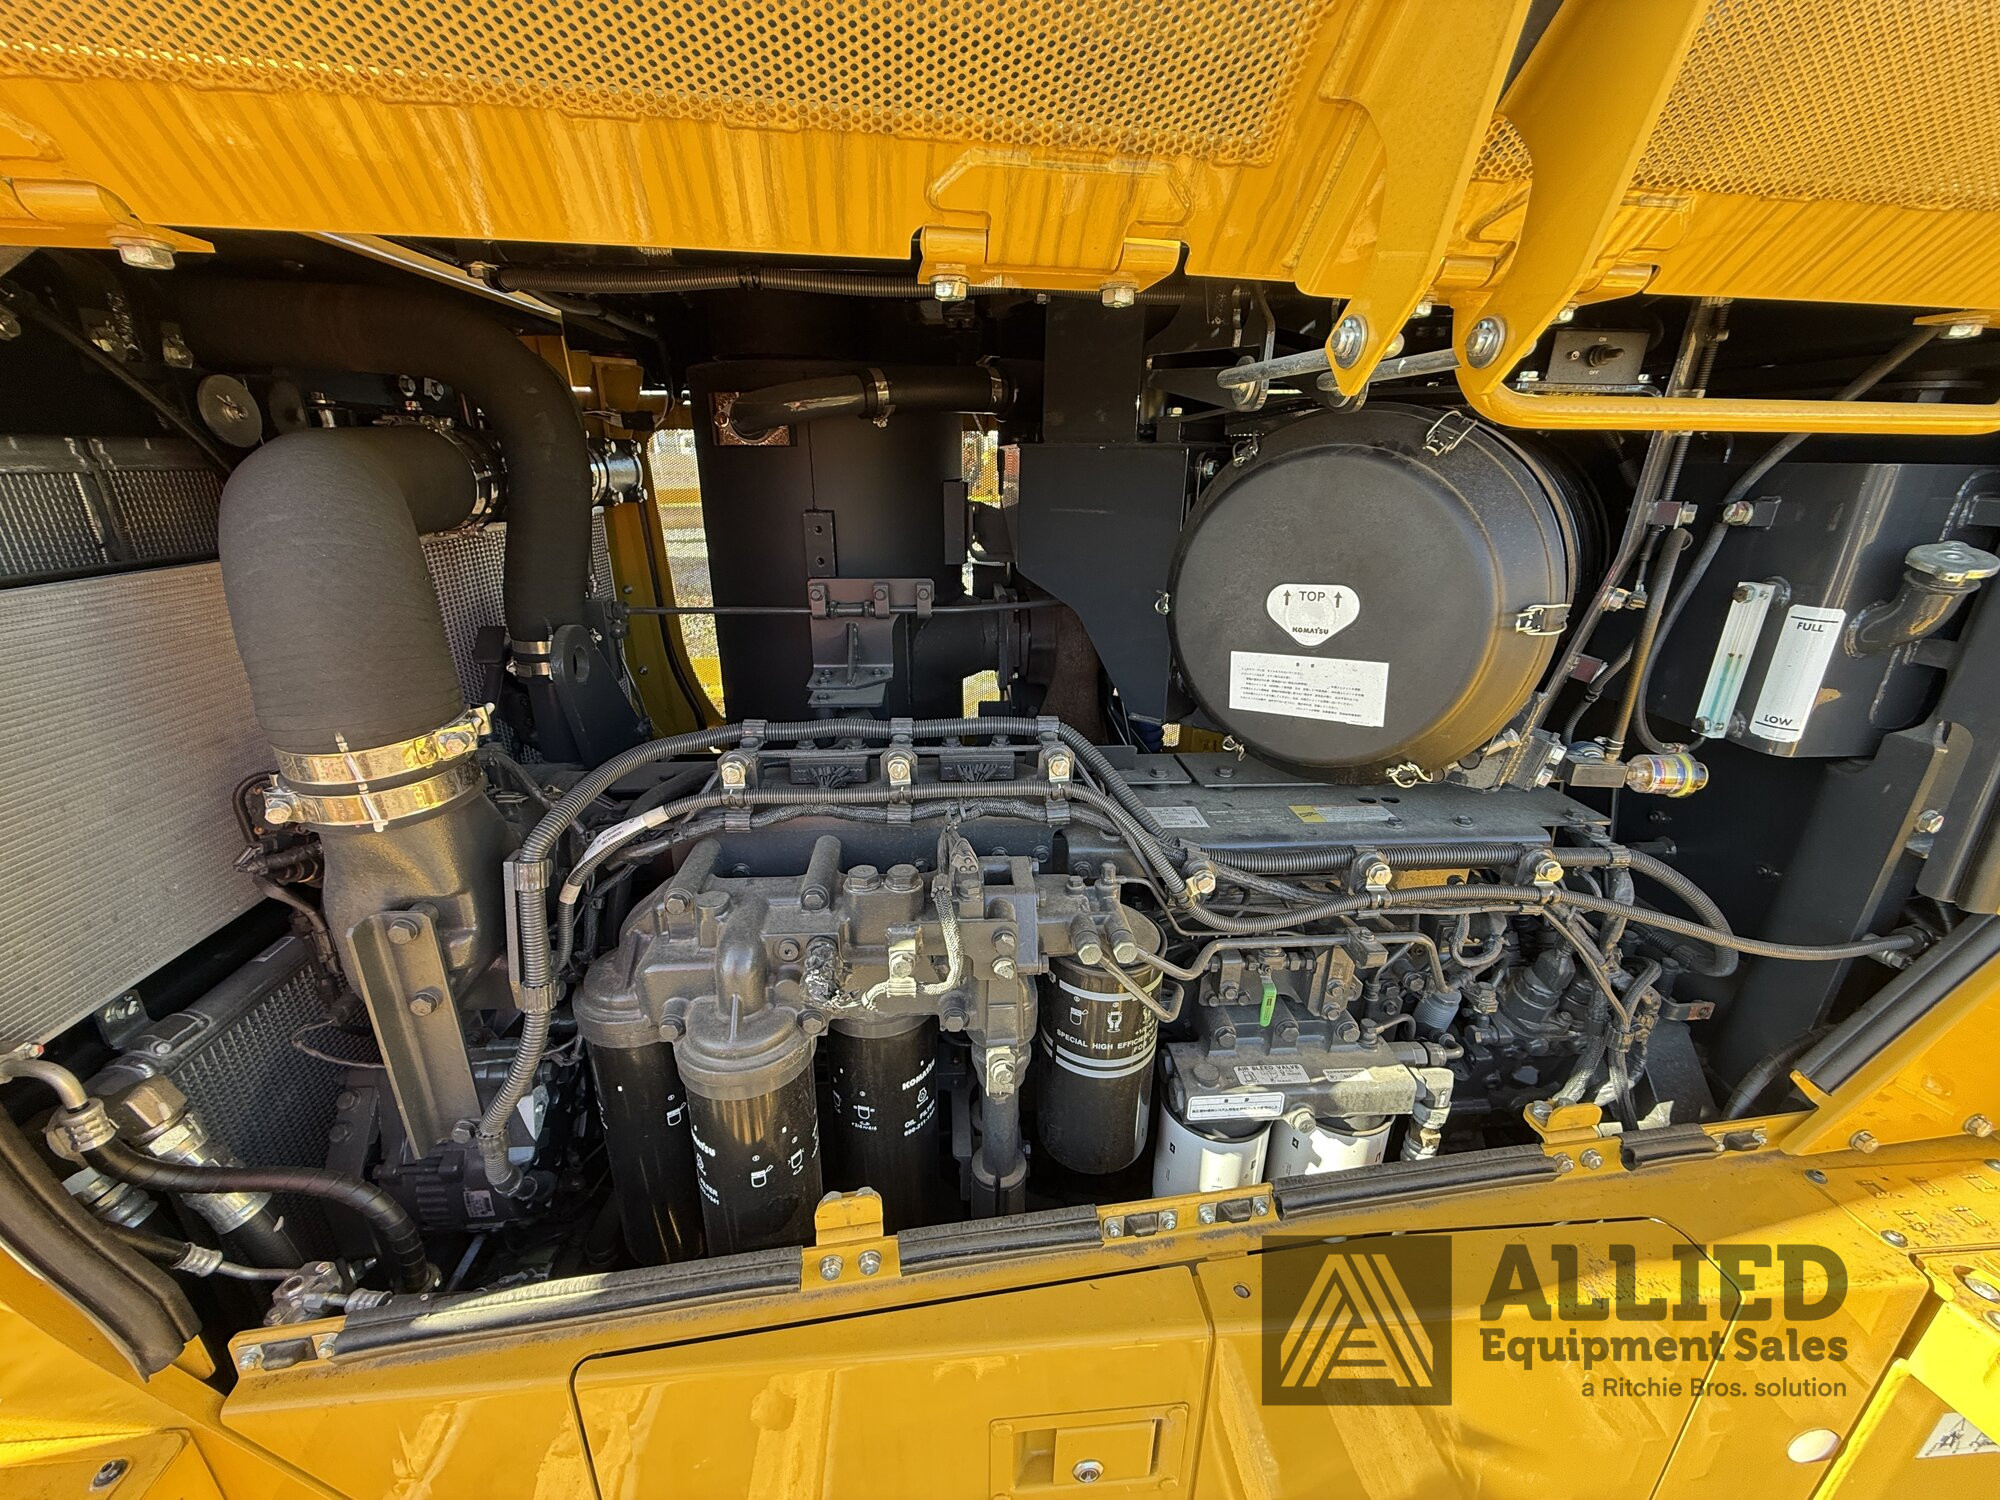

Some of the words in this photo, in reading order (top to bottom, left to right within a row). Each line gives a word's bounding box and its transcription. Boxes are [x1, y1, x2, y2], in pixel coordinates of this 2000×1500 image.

[1299, 591, 1326, 602] TOP
[1292, 626, 1329, 636] KOMATSU
[1796, 621, 1824, 633] FULL
[1763, 714, 1793, 726] LOW
[1056, 1028, 1088, 1048] SPECIAL
[1092, 1042, 1113, 1050] HIGH
[1117, 1027, 1155, 1050] EFFICIENCY
